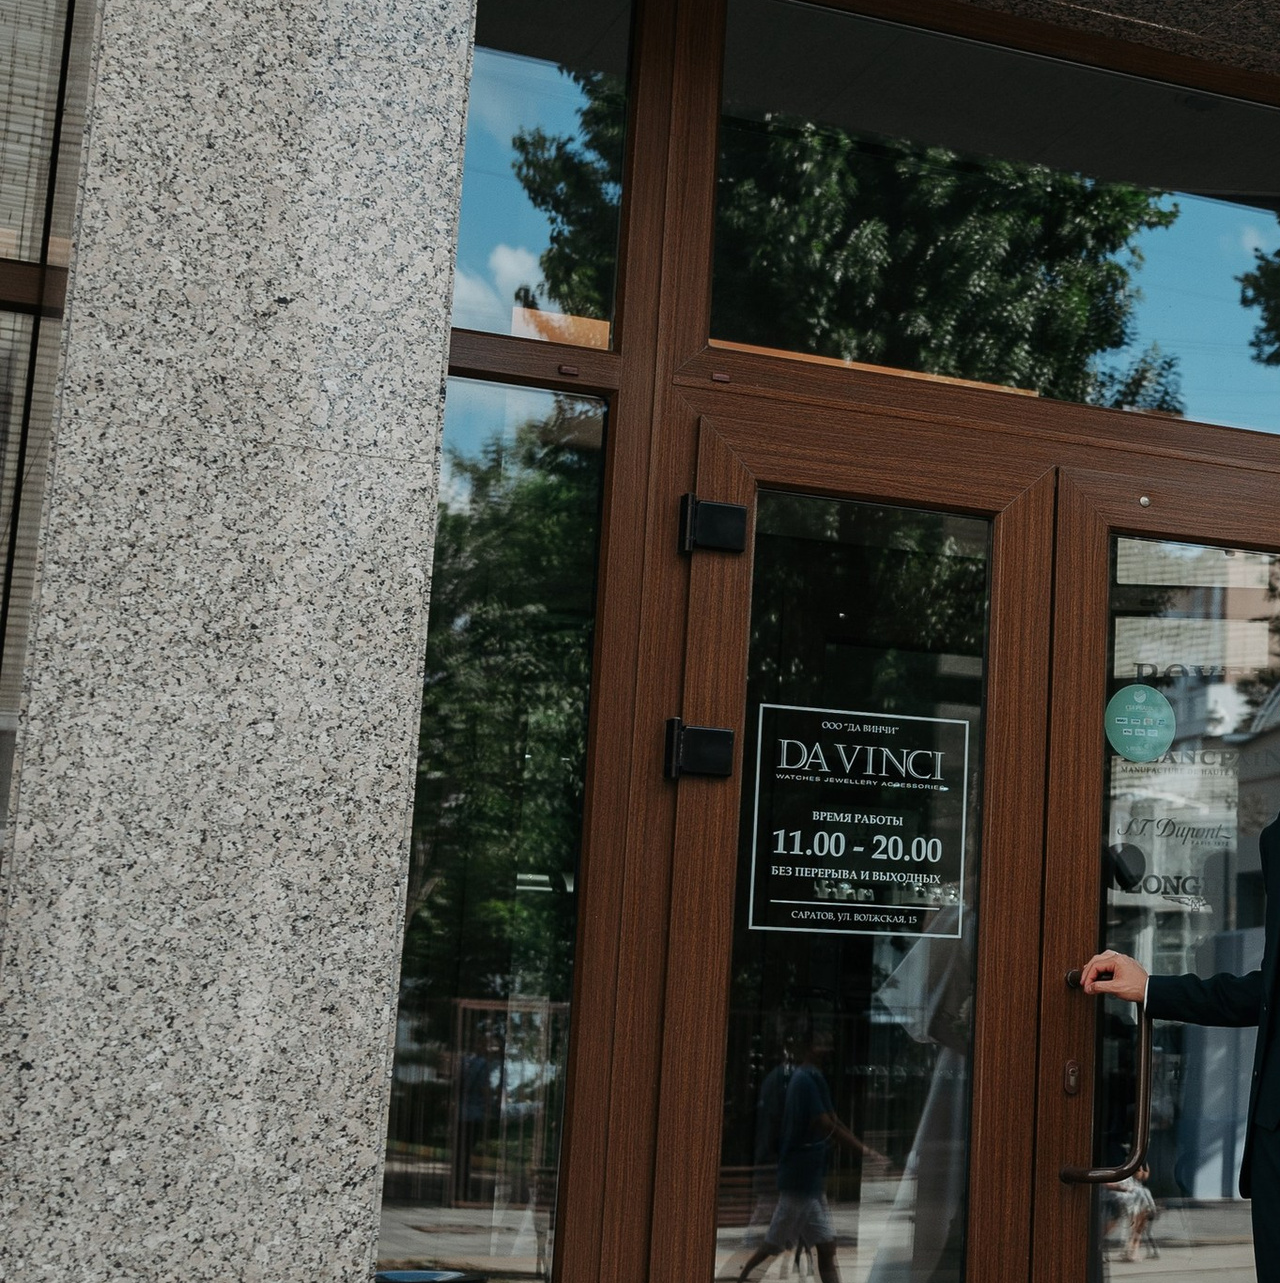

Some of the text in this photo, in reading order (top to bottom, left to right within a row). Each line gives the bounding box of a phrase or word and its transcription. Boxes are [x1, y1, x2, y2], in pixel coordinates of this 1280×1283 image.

[821, 721, 843, 730] ООО
[863, 724, 899, 734] ВИНЧИ"
[776, 739, 946, 780] DA VINCI
[775, 773, 821, 783] WATCHES
[824, 776, 878, 786] JEWELLERY
[812, 811, 903, 826] ВРЕМЯ РАБОТЫ
[1155, 817, 1233, 845] Dupont
[772, 829, 845, 857] 11.00
[871, 835, 942, 863] 20.00
[771, 866, 941, 884] БЕЗ ПЕРЕРЫВА И ВЫХОДНЫХ
[791, 911, 836, 921] САРАТОВ,
[854, 913, 907, 924] ВОЛЖСКАЯ,
[908, 916, 917, 924] 15
